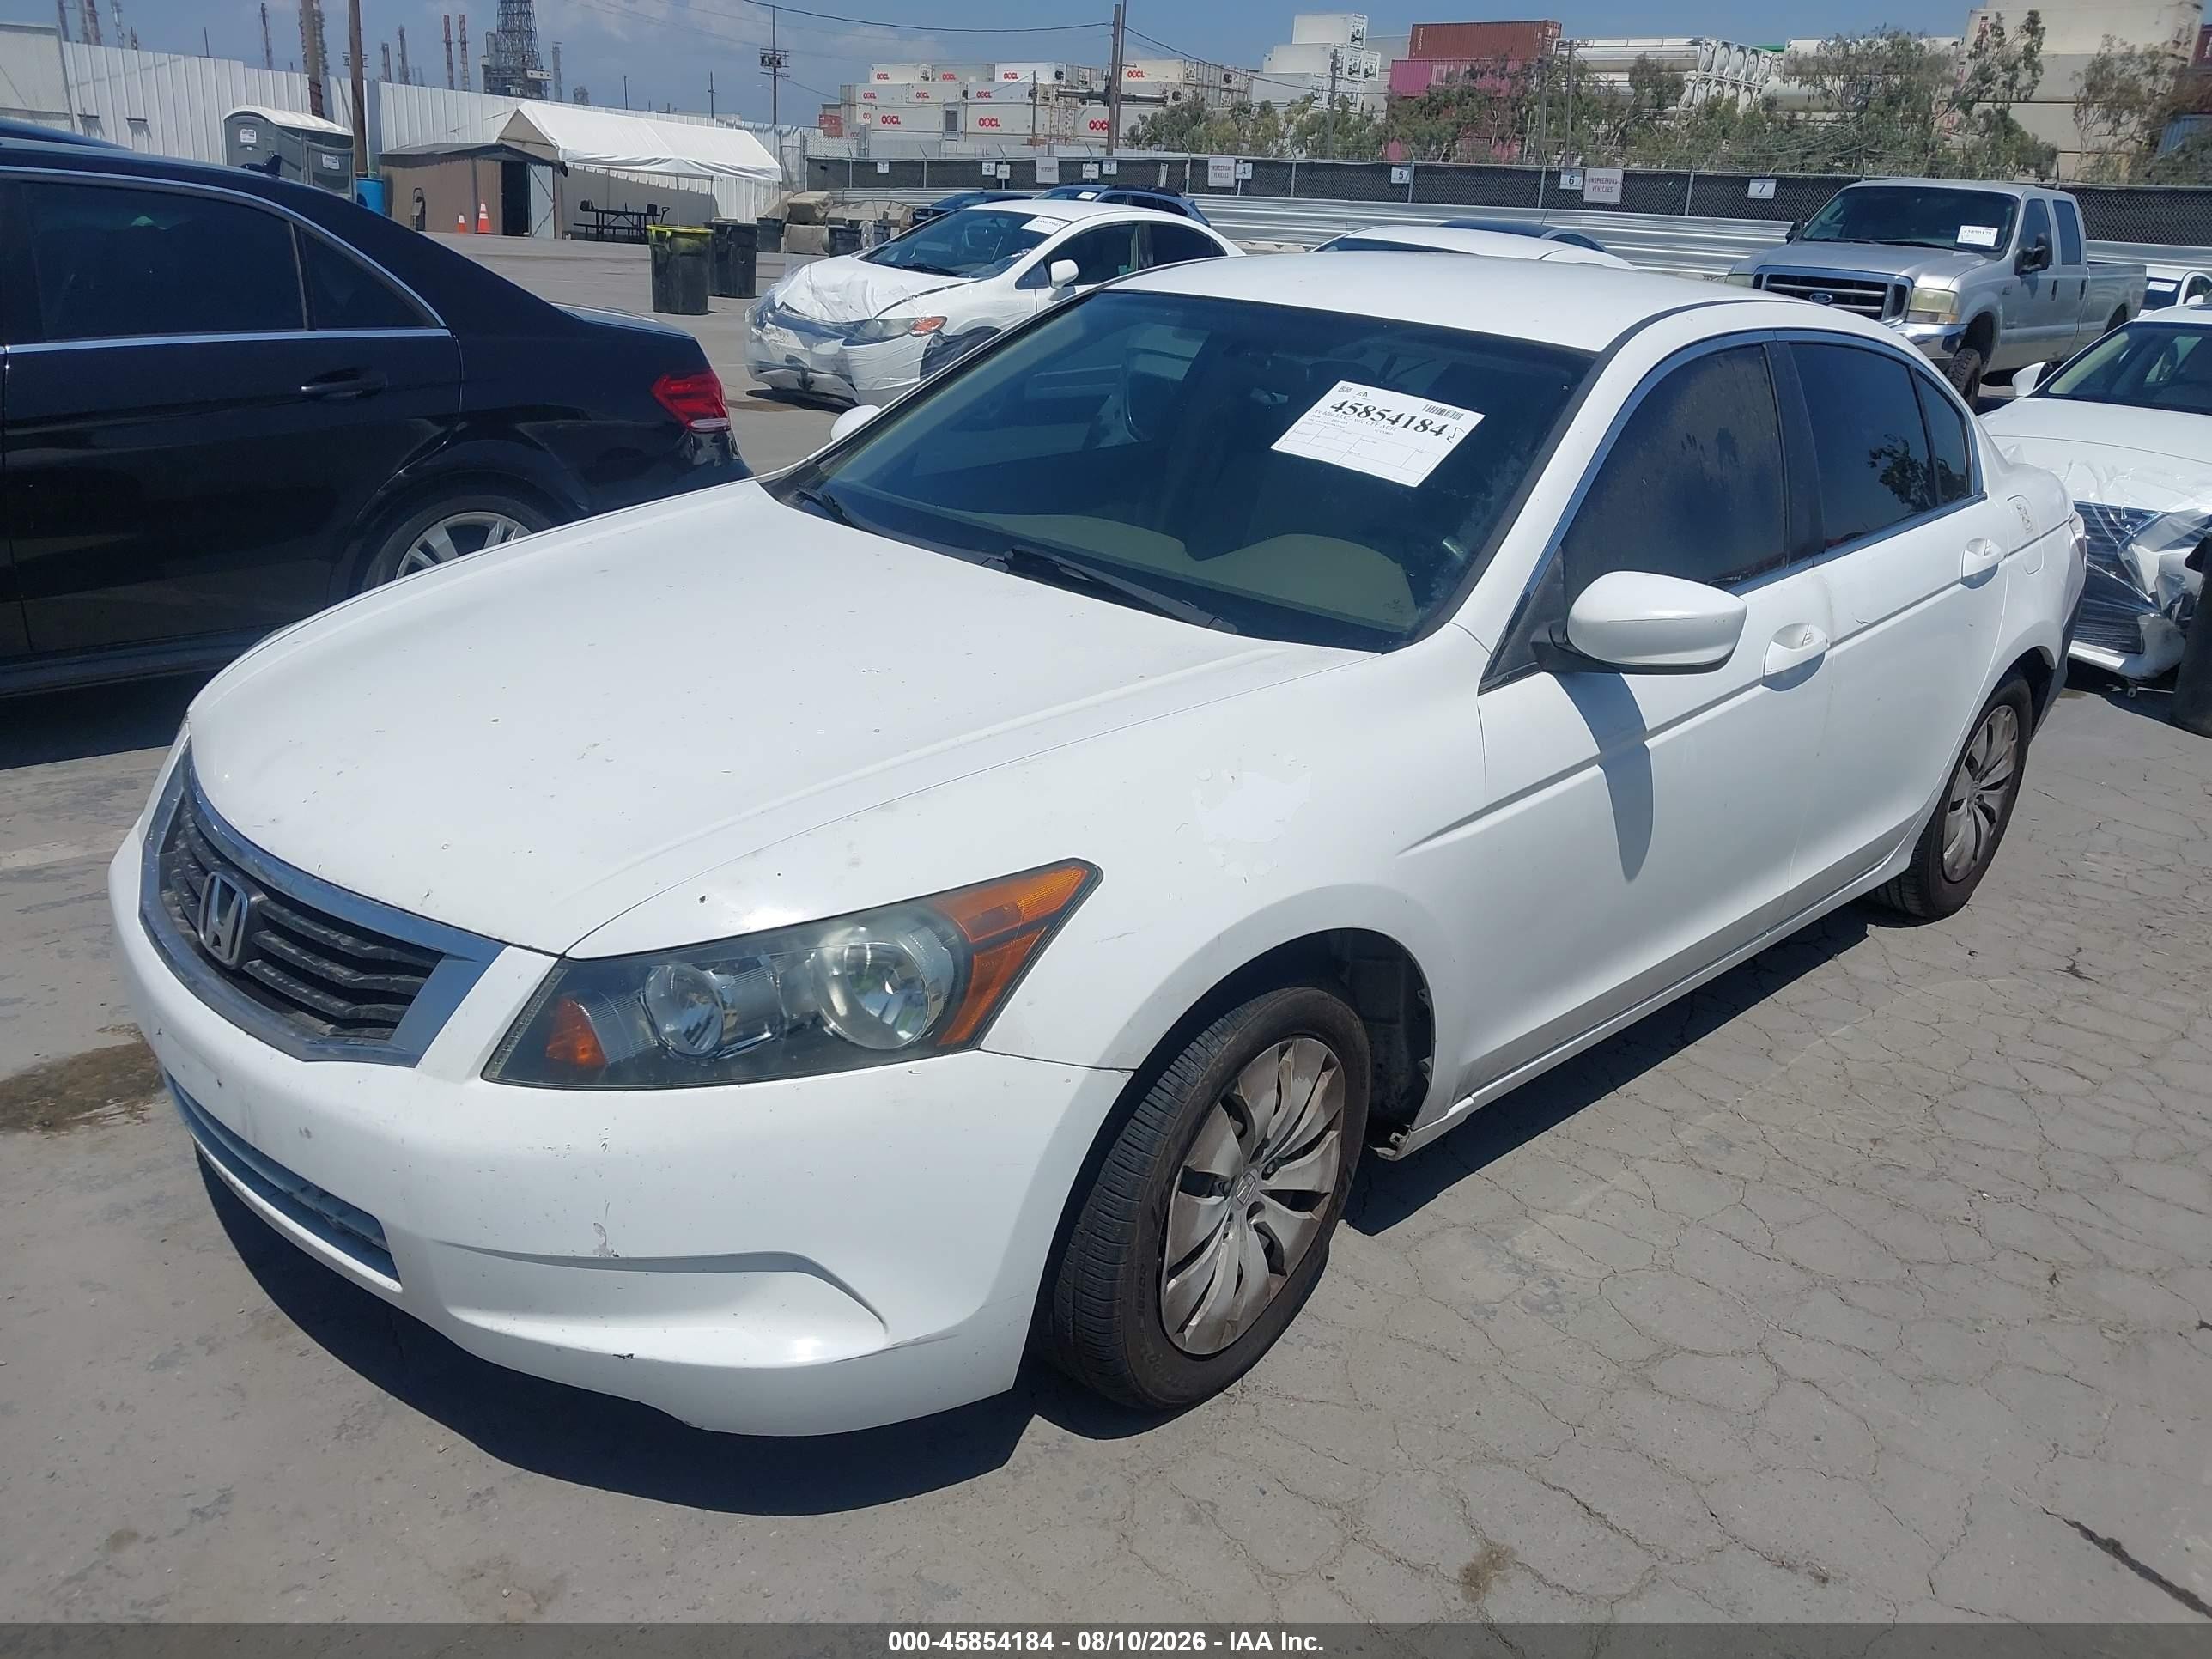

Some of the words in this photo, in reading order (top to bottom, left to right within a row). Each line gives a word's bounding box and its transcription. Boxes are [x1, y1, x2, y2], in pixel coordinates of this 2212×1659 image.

[1127, 70, 1145, 78] OOCL
[881, 115, 901, 125] OOCL
[978, 117, 1000, 127] OOCL
[1089, 120, 1109, 131] OOC
[1242, 167, 1246, 175] 4
[1398, 170, 1404, 179] 5
[1568, 175, 1575, 185] 6
[1759, 184, 1766, 193] 7
[1329, 400, 1449, 437] 45854184
